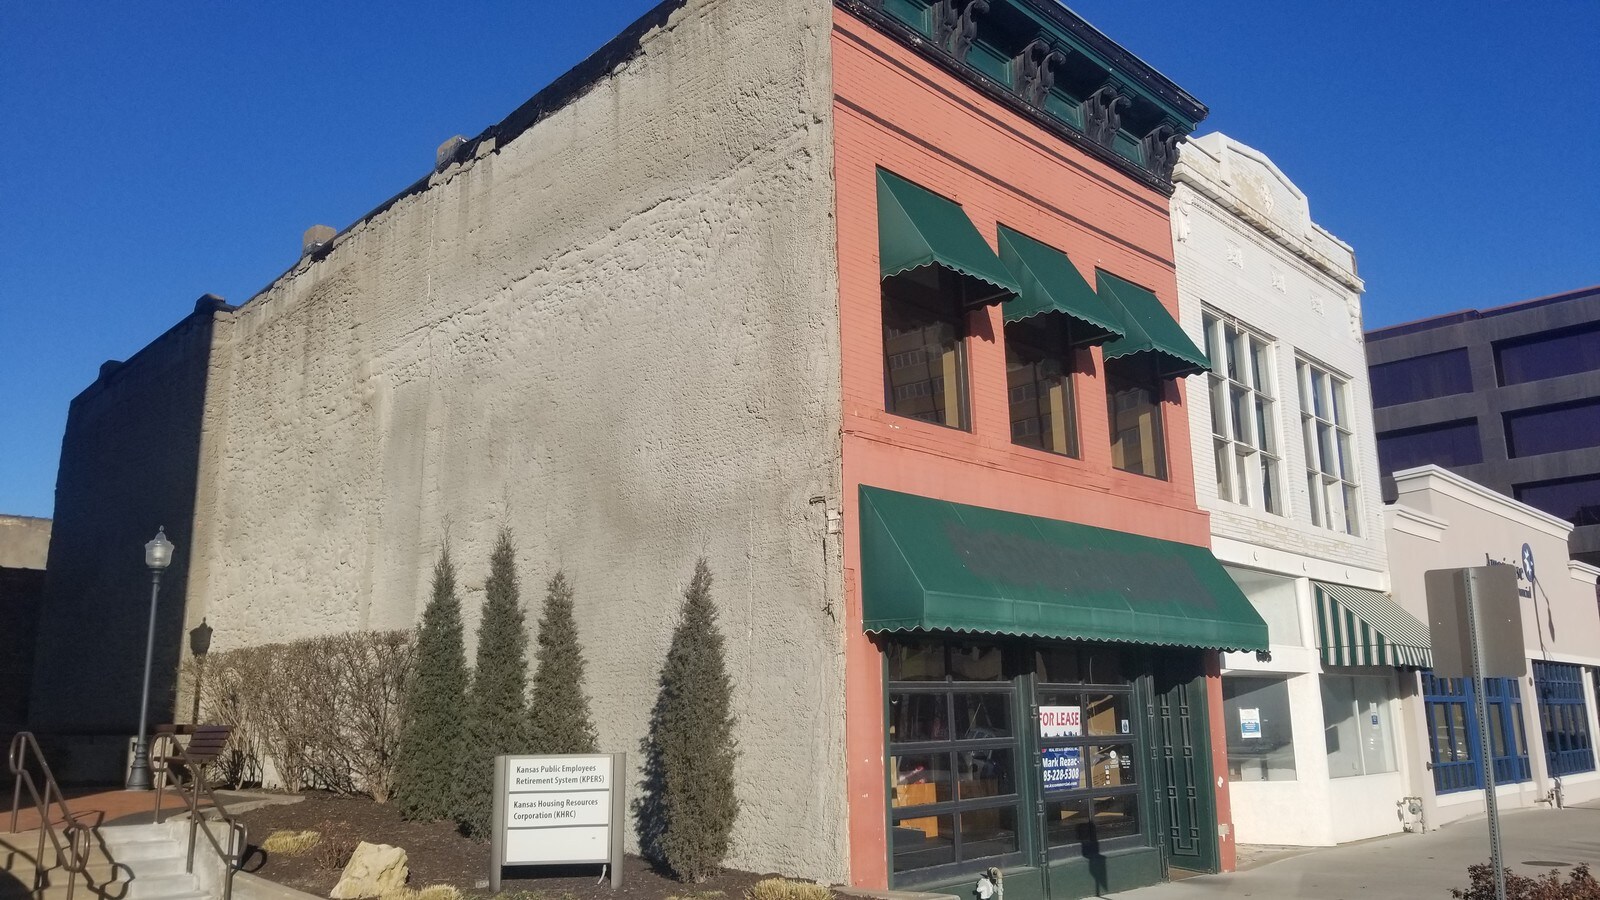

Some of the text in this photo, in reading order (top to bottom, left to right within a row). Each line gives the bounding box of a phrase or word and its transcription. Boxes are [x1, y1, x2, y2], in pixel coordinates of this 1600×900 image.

[1057, 712, 1079, 726] LEASE
[1042, 757, 1058, 768] Mark
[540, 765, 560, 773] Public
[561, 764, 596, 773] Employees
[516, 775, 604, 785] Retirement System (KPERS)
[538, 800, 564, 808] Housing
[513, 810, 576, 821] Corporation (KHRC)
